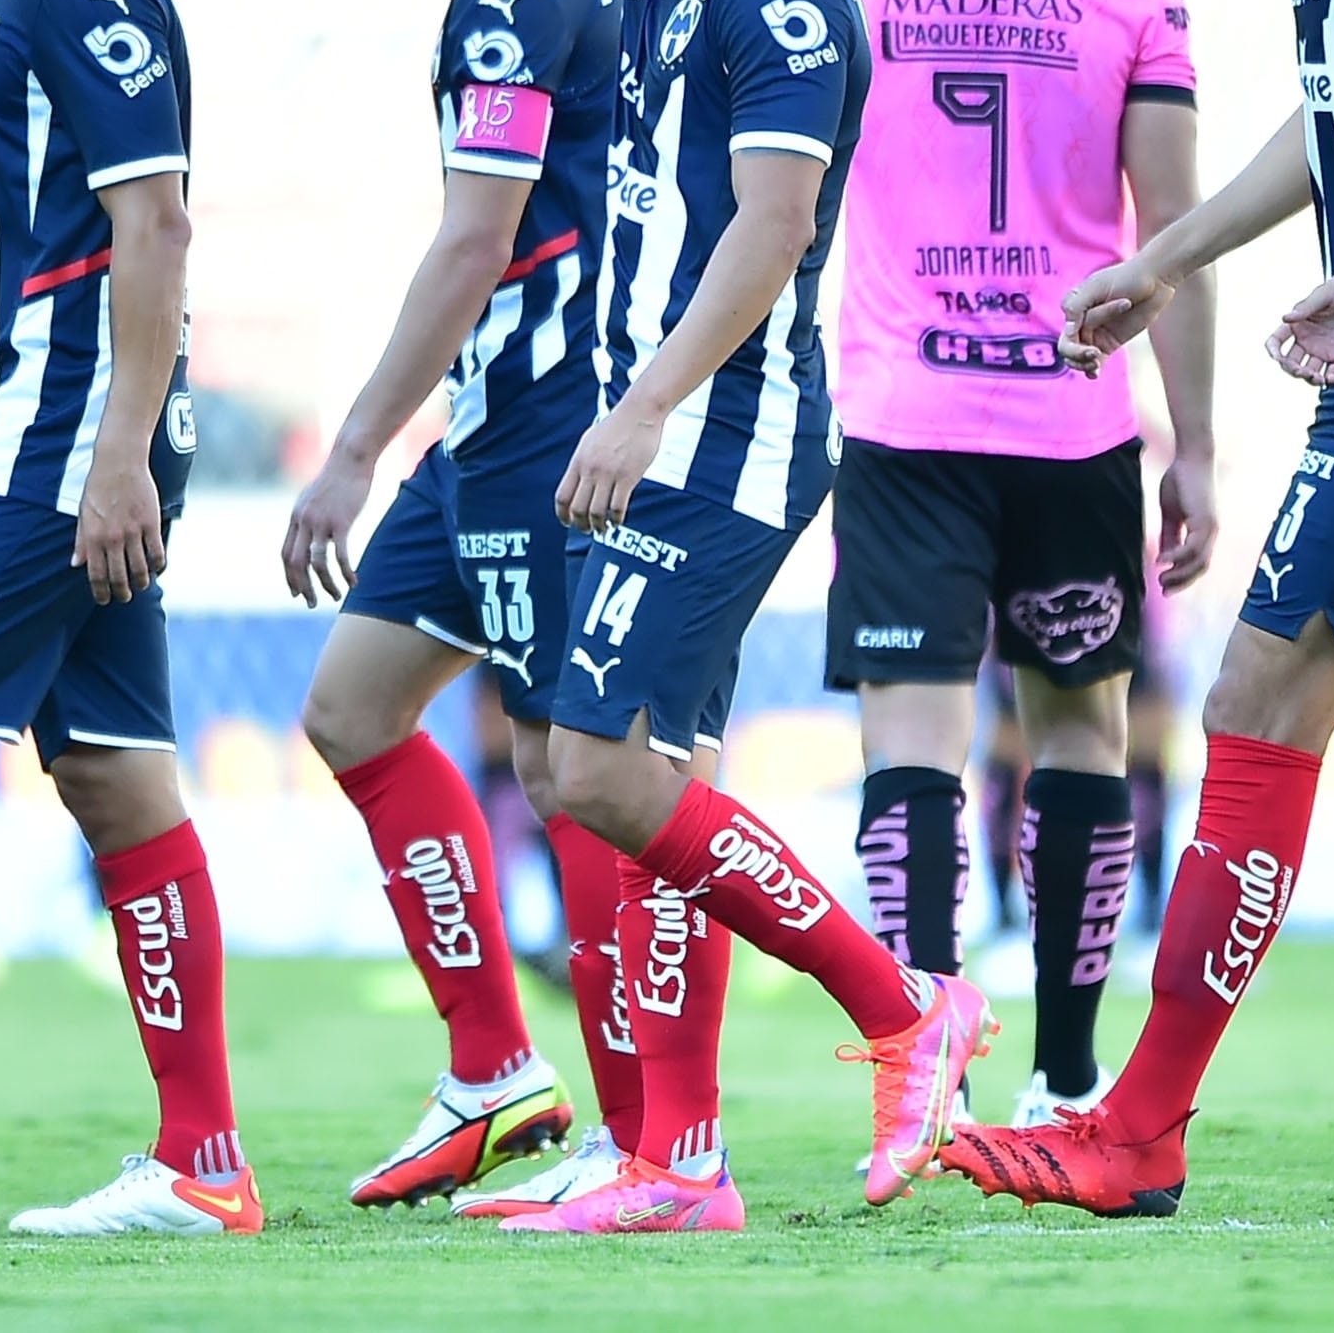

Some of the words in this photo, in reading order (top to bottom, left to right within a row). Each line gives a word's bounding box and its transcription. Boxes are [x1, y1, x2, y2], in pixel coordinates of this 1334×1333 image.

[787, 42, 839, 76] Berel
[902, 22, 1068, 53] PAQUETEXPRESS
[119, 55, 169, 99] Berel
[933, 71, 1008, 234] 9
[915, 245, 1036, 276] JONATHAN
[936, 335, 1057, 367] H-E-B
[1274, 482, 1318, 554] 3
[477, 569, 535, 642] 33
[582, 561, 649, 647] 14
[856, 625, 925, 651] CHARLY
[400, 838, 483, 969] Escudo
[707, 827, 834, 932] Escudo
[1202, 849, 1290, 1006] Escudo
